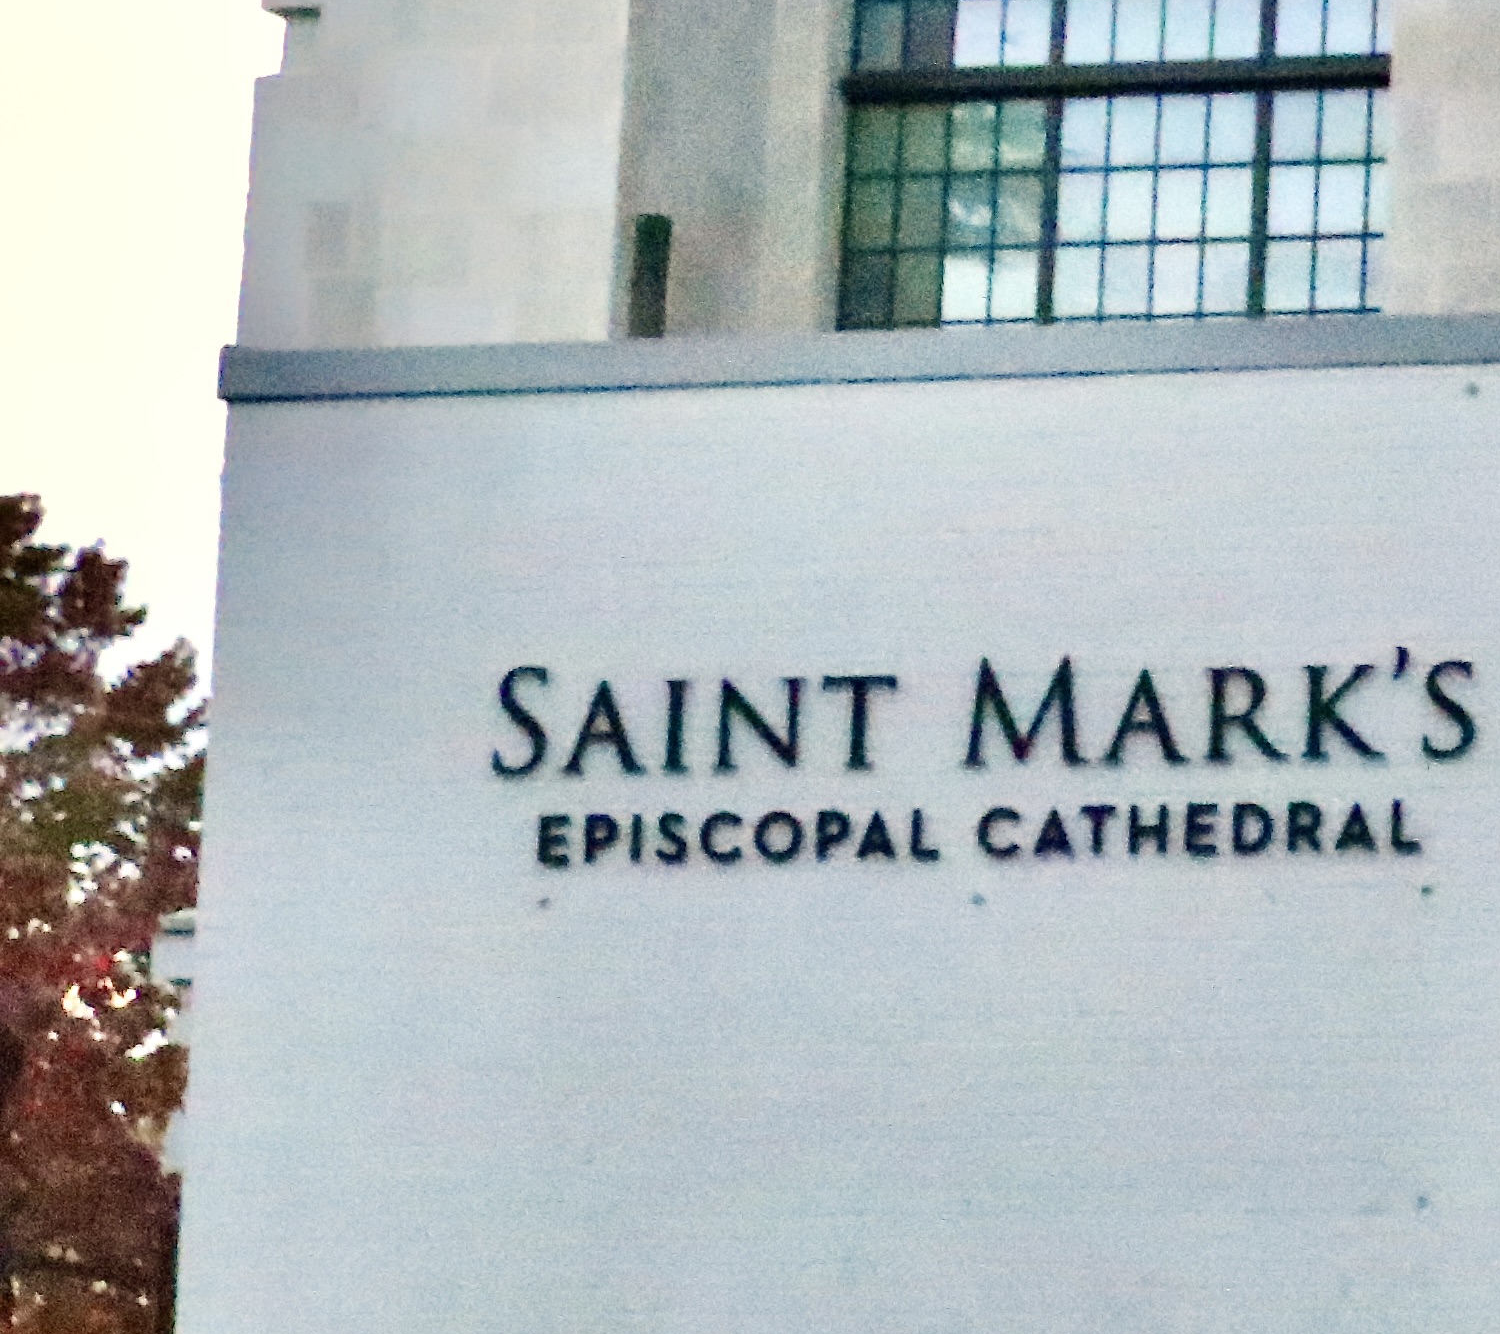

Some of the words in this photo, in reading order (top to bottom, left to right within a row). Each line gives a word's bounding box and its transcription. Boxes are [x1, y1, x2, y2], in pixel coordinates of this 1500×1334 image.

[489, 664, 900, 782] SAINT
[961, 645, 1479, 771] MARK'S
[535, 808, 942, 872] EPISCOPAL
[975, 799, 1424, 863] CATHEDRAL
